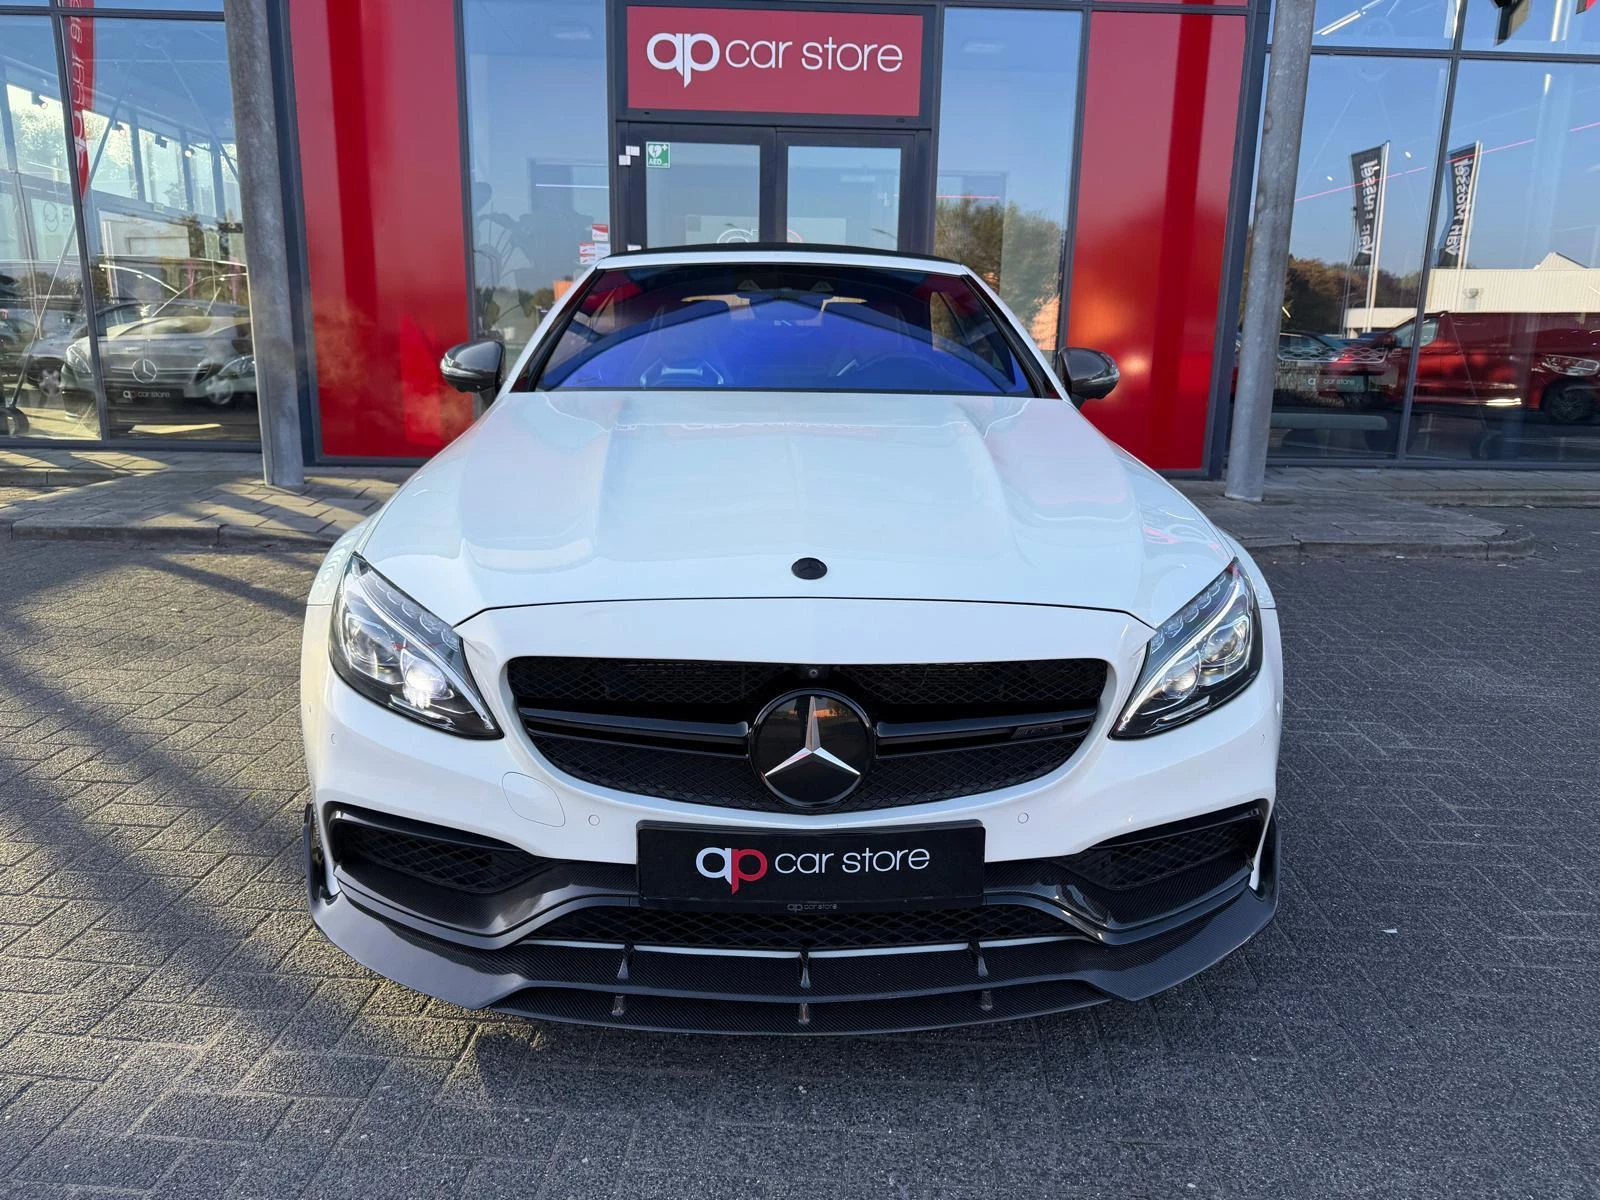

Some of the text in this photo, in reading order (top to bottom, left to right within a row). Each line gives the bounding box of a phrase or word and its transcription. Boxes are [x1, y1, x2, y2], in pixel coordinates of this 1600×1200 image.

[646, 32, 903, 88] ap car store
[696, 847, 931, 895] ap car store
